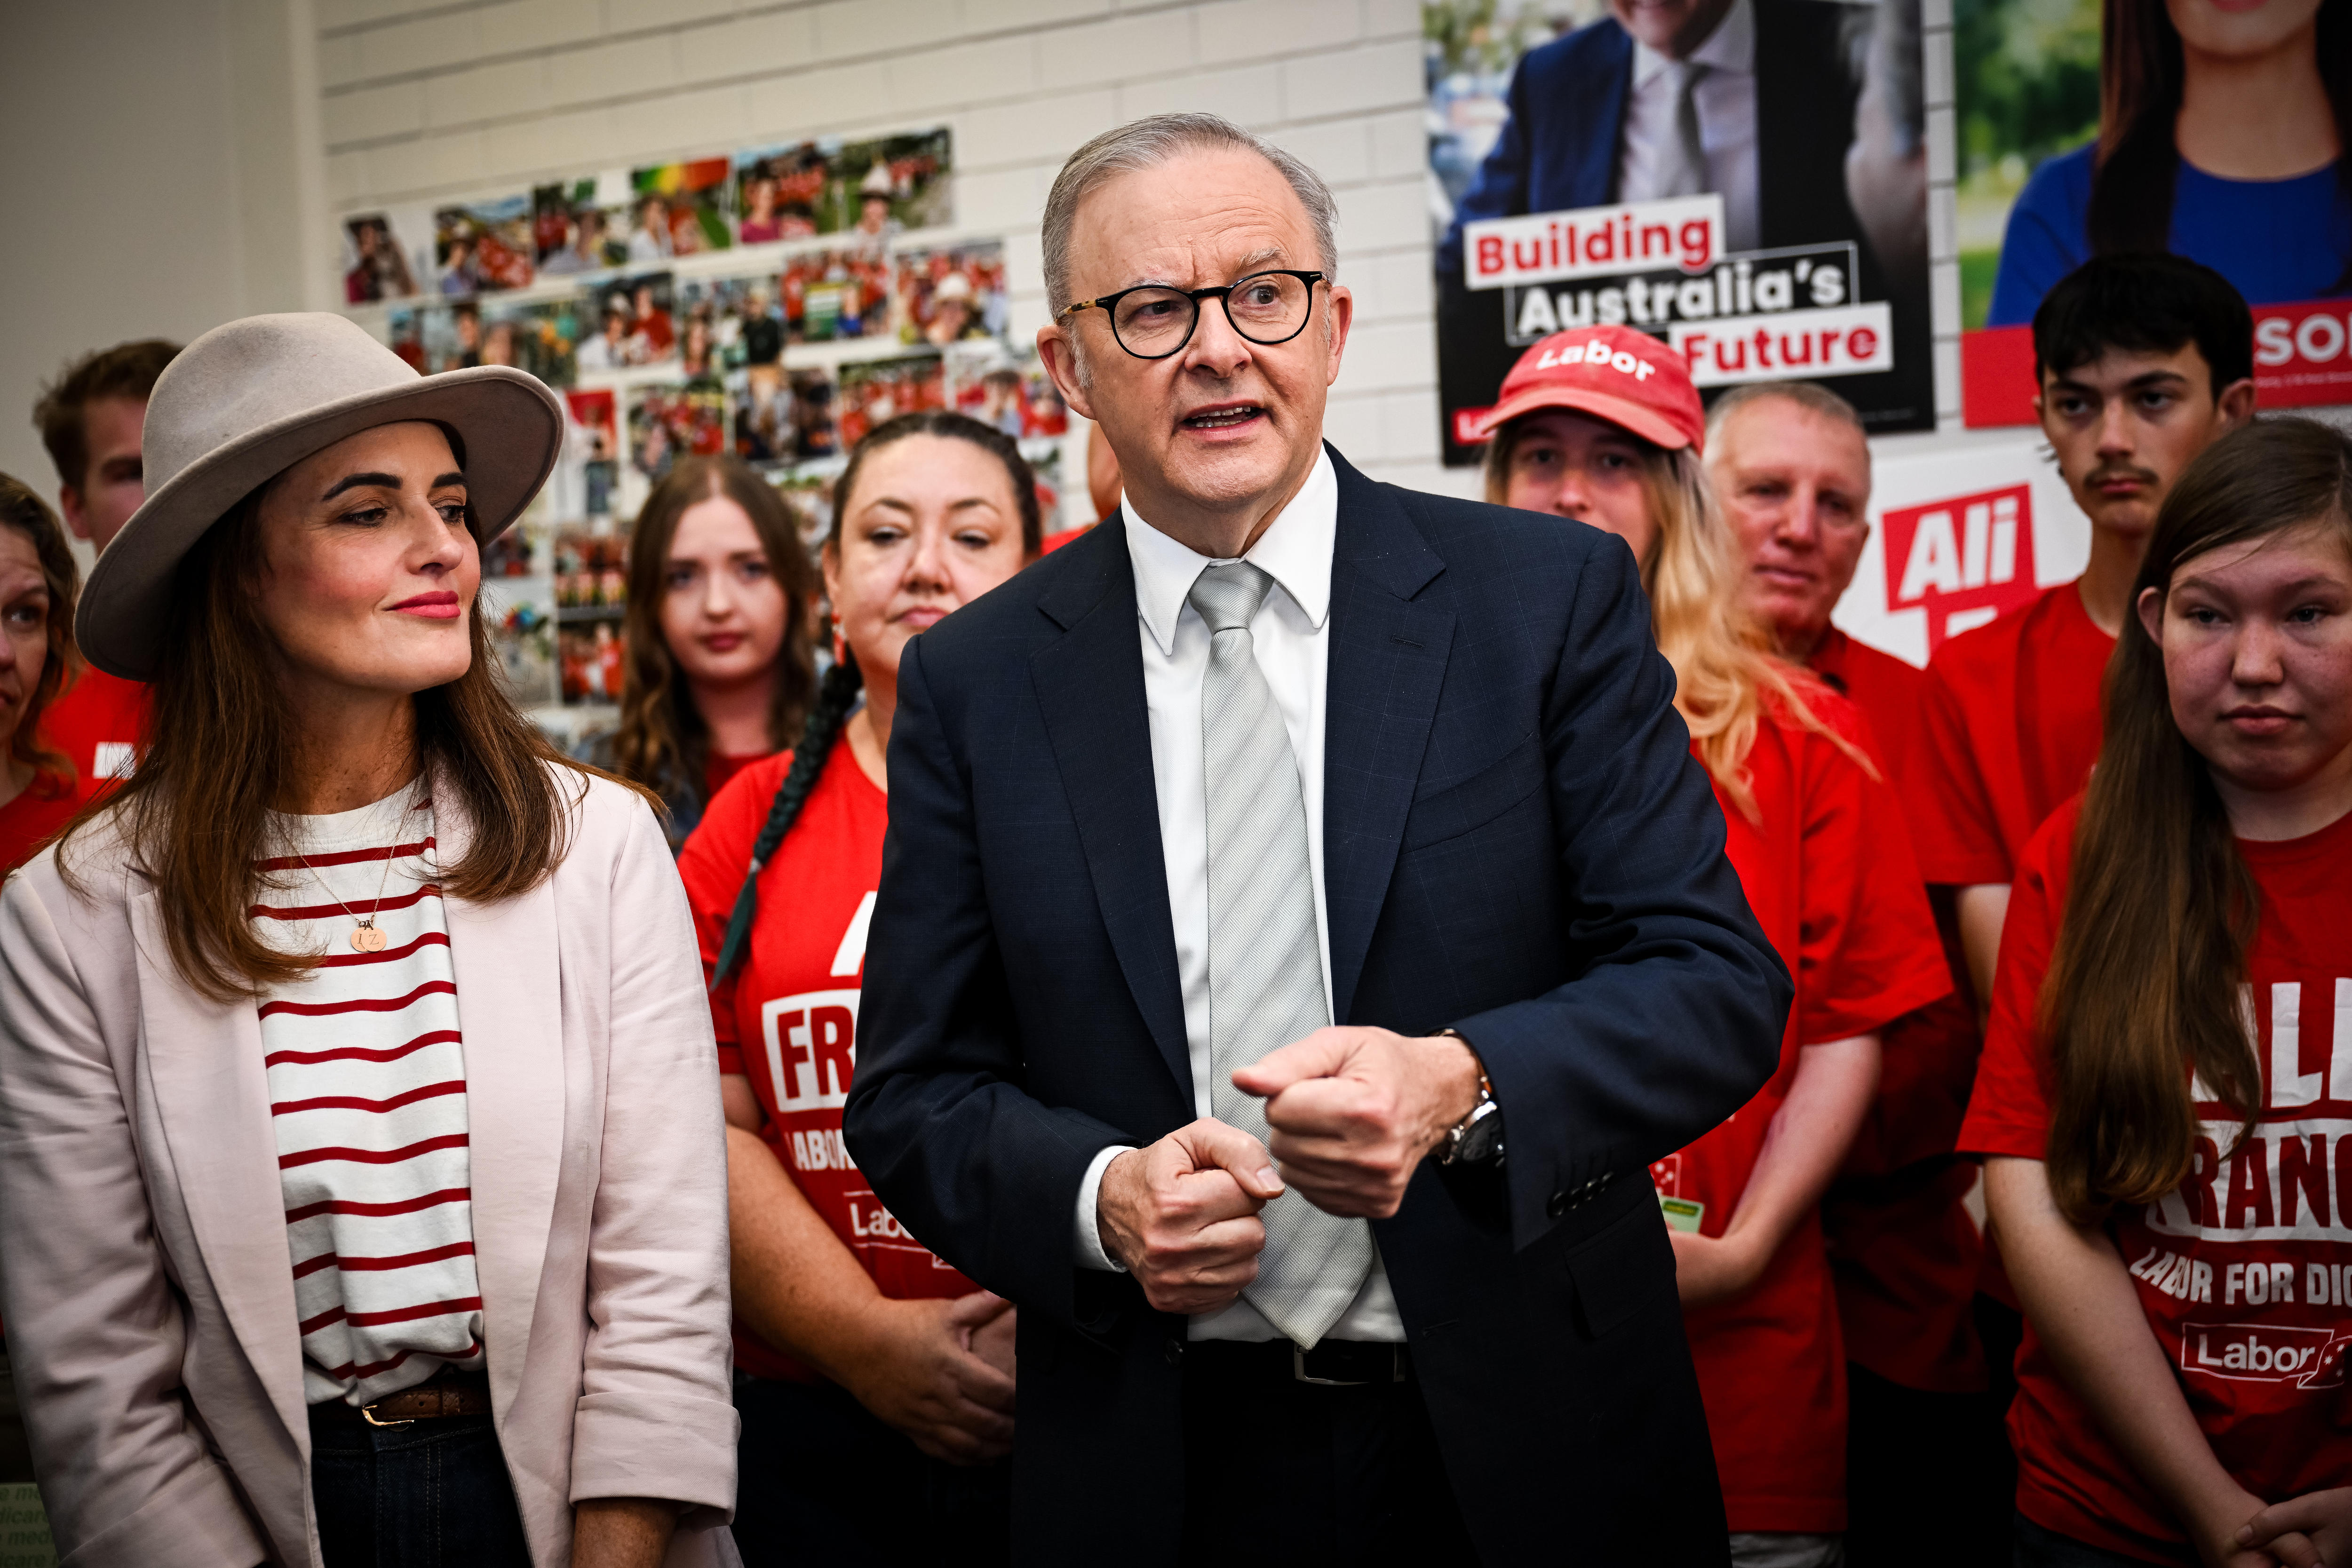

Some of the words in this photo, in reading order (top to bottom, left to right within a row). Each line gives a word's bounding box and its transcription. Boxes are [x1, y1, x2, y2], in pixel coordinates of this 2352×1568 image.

[1476, 214, 1712, 272] Building
[1518, 258, 1845, 335] Australia's
[1536, 339, 1655, 382] Labor
[1684, 327, 1877, 371] Future
[2254, 311, 2352, 367] SO
[1897, 496, 2018, 601] Ali
[368, 934, 379, 945] Z
[2190, 977, 2352, 1108] LI
[2156, 1132, 2352, 1231] RAN
[2129, 1246, 2213, 1304] LABOR
[2225, 1262, 2295, 1305] FOR
[2197, 1333, 2316, 1372] Labor
